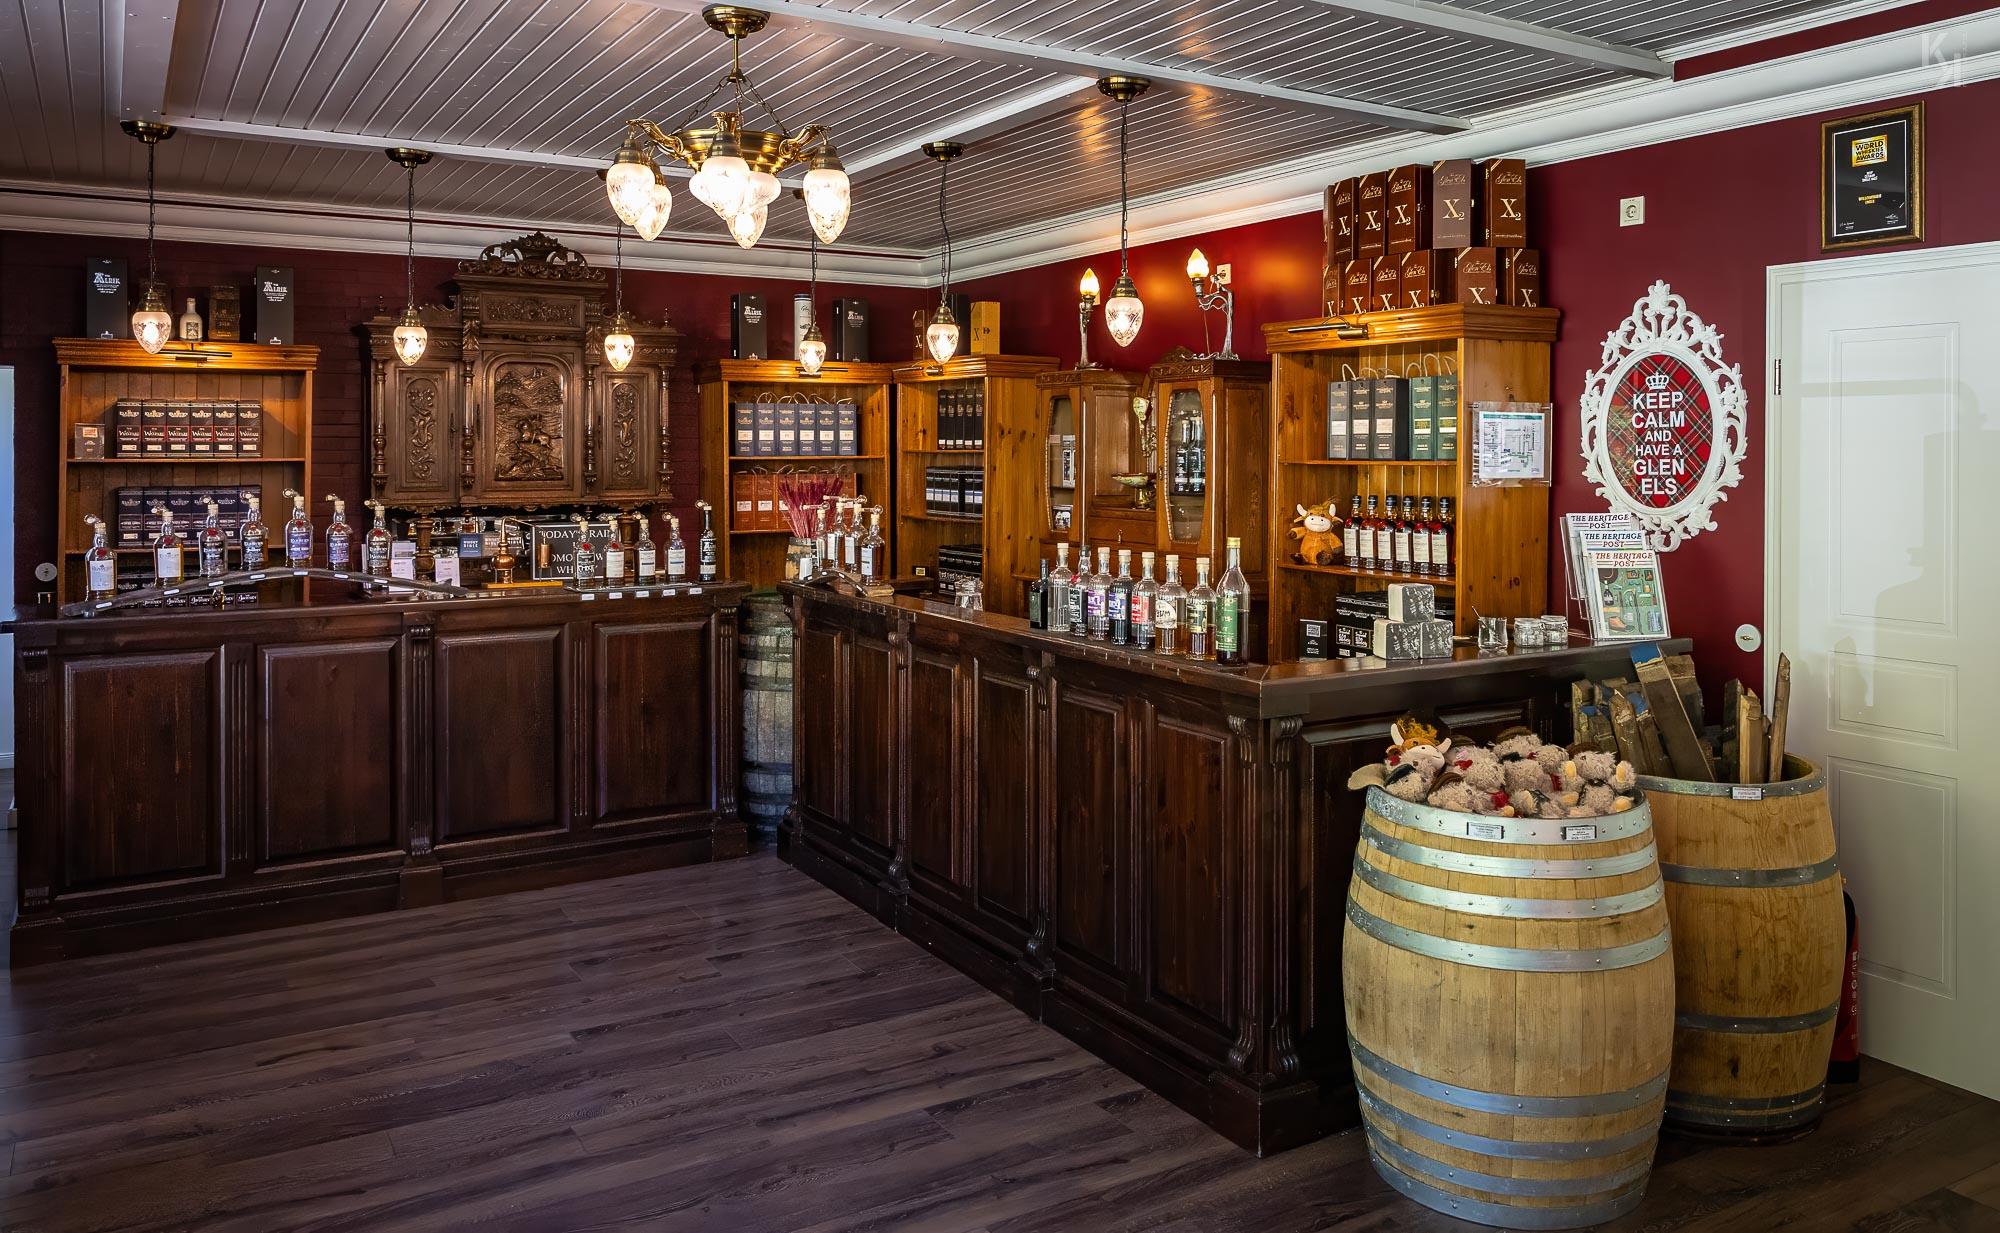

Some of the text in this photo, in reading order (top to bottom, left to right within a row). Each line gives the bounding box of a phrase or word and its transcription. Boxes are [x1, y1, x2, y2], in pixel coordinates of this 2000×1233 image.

[1856, 140, 1884, 151] WORLD
[1856, 147, 1884, 156] WHISKIES
[1856, 152, 1884, 161] AWARDS
[1633, 392, 1683, 409] KEEP
[1632, 411, 1685, 428] CALM
[1645, 430, 1672, 442] AND
[1636, 444, 1682, 456] HAVE A
[1634, 459, 1684, 475] GLEN
[1642, 478, 1677, 494] ELS
[1588, 514, 1629, 522] HERITAGE
